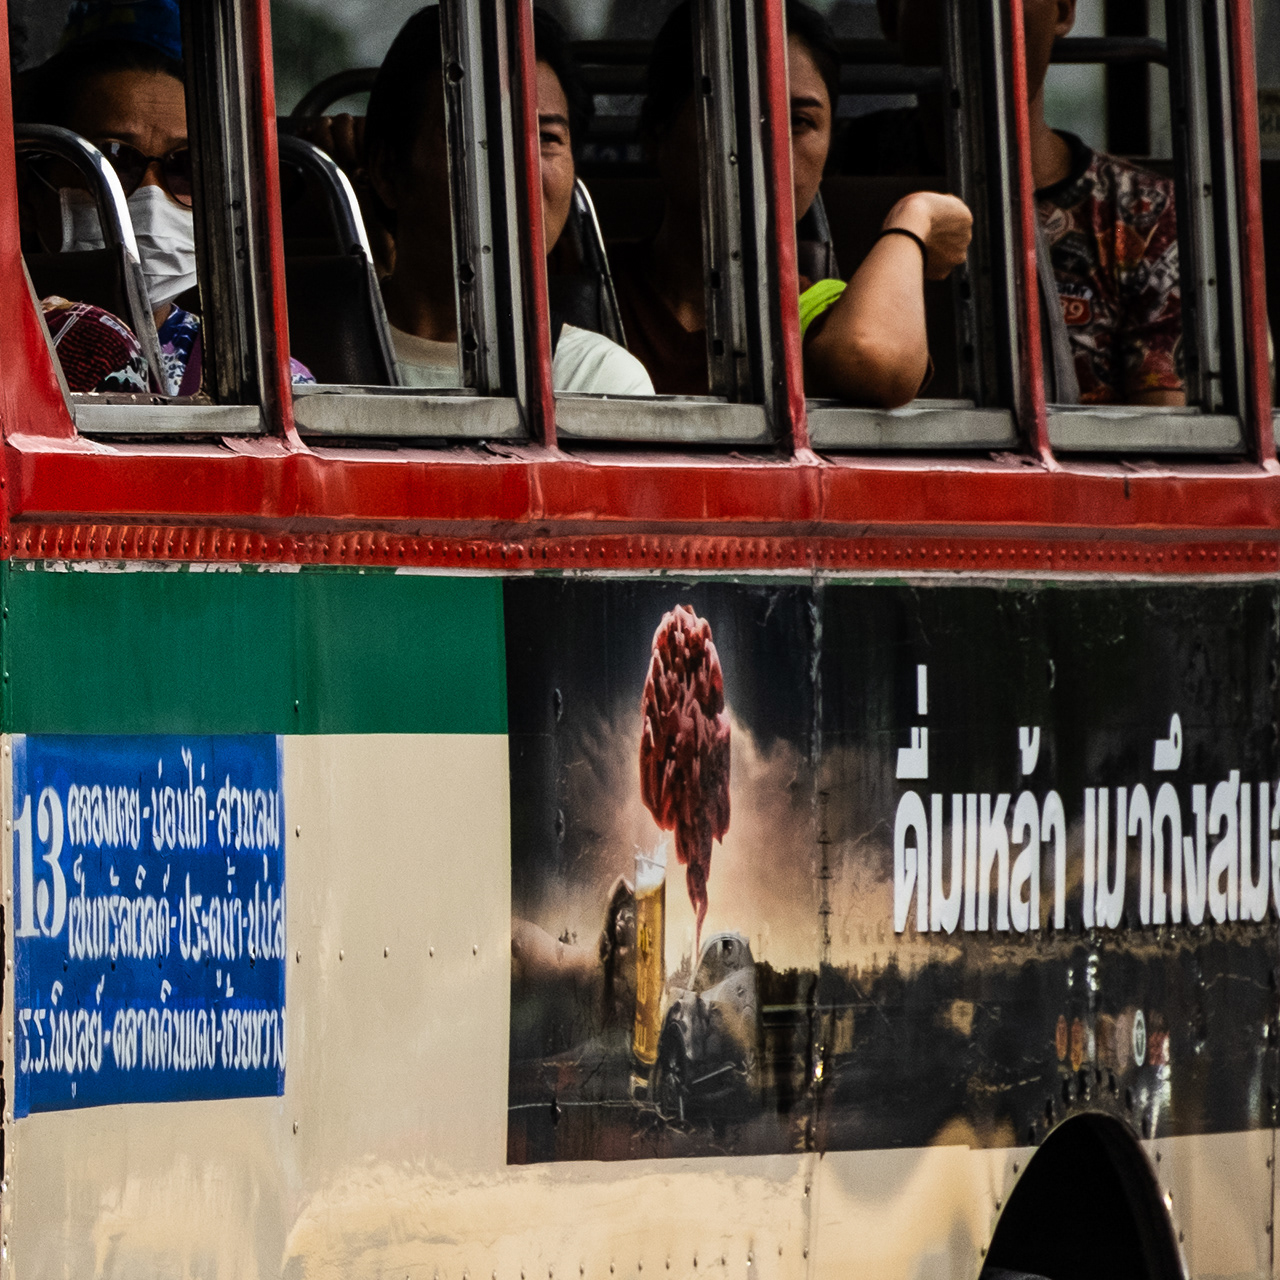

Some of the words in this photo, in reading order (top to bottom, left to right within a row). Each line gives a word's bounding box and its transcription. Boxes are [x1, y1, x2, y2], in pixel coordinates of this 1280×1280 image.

[13, 786, 68, 938] 13
[893, 663, 1067, 935] ดื่มเหล้า
